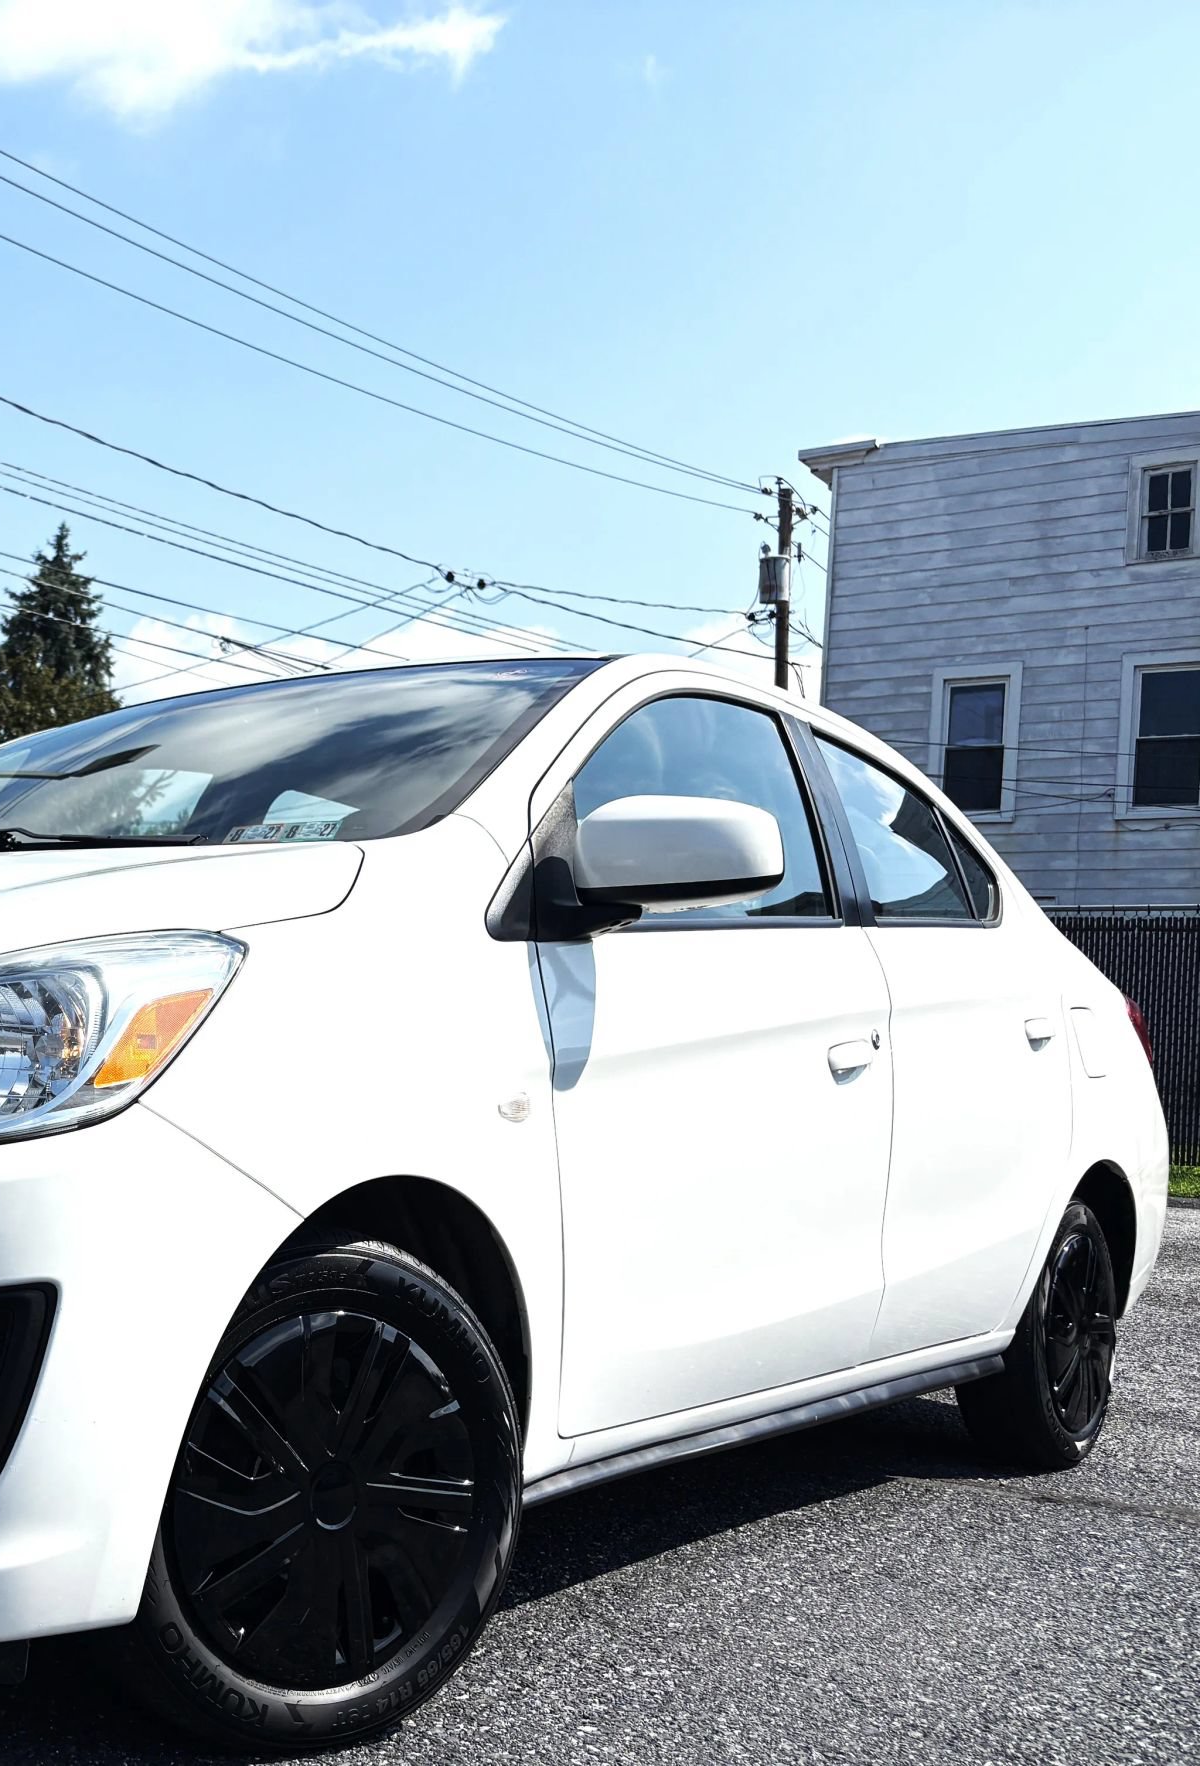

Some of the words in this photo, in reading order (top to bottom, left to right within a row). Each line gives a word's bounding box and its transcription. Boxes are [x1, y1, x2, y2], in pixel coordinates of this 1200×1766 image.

[263, 826, 280, 840] 27
[318, 823, 338, 837] 27
[417, 1625, 470, 1687] 165/65
[158, 1621, 270, 1728] KUMHO
[376, 1681, 413, 1714] R14
